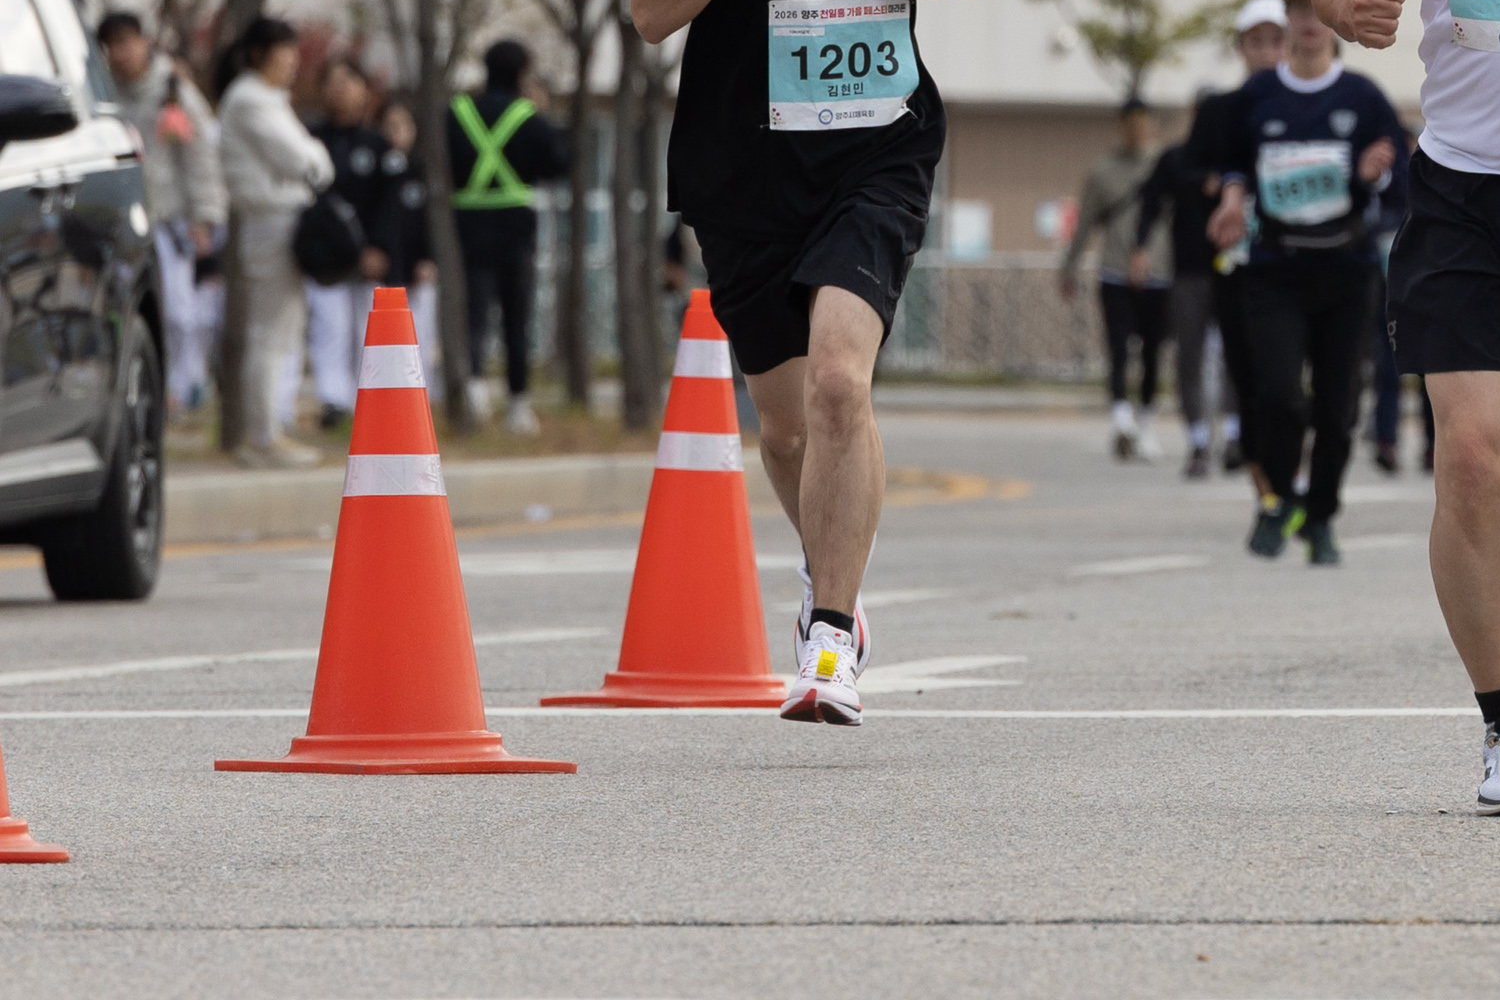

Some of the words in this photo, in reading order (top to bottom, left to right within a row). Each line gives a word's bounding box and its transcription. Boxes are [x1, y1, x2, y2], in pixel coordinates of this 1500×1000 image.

[774, 10, 798, 20] 2026
[801, 9, 820, 20] 양주
[820, 8, 846, 20] 천일홍
[846, 6, 862, 18] 가을
[791, 40, 899, 80] 1203
[827, 81, 864, 98] 김현민
